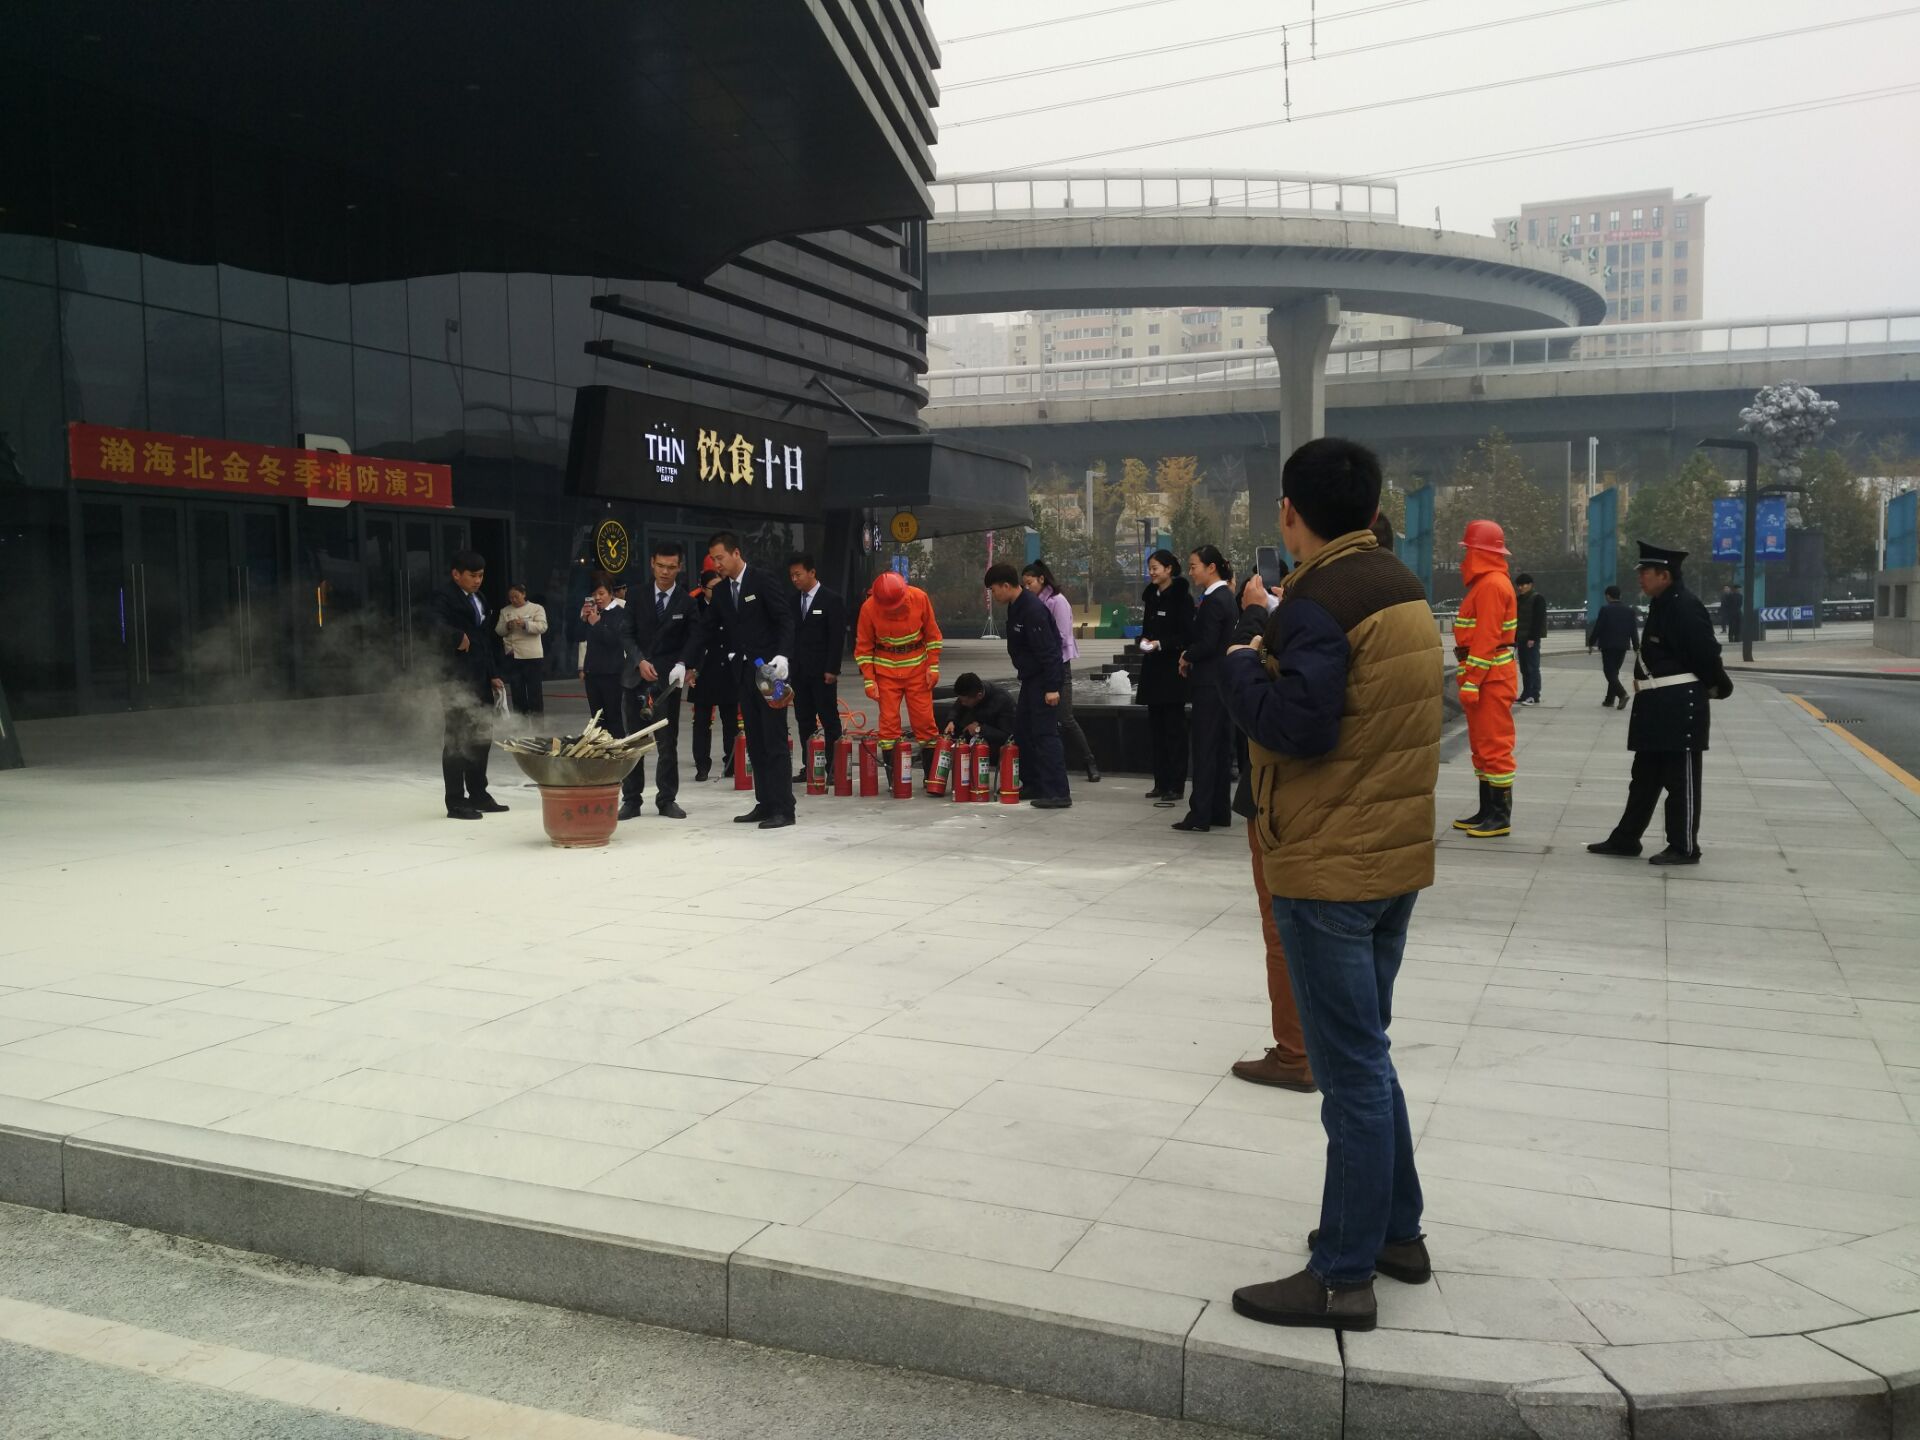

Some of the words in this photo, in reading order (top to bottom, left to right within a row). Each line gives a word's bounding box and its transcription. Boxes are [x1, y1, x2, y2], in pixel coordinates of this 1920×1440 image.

[99, 435, 433, 499] 瀚海北金冬季消防演习
[644, 433, 686, 465] THN
